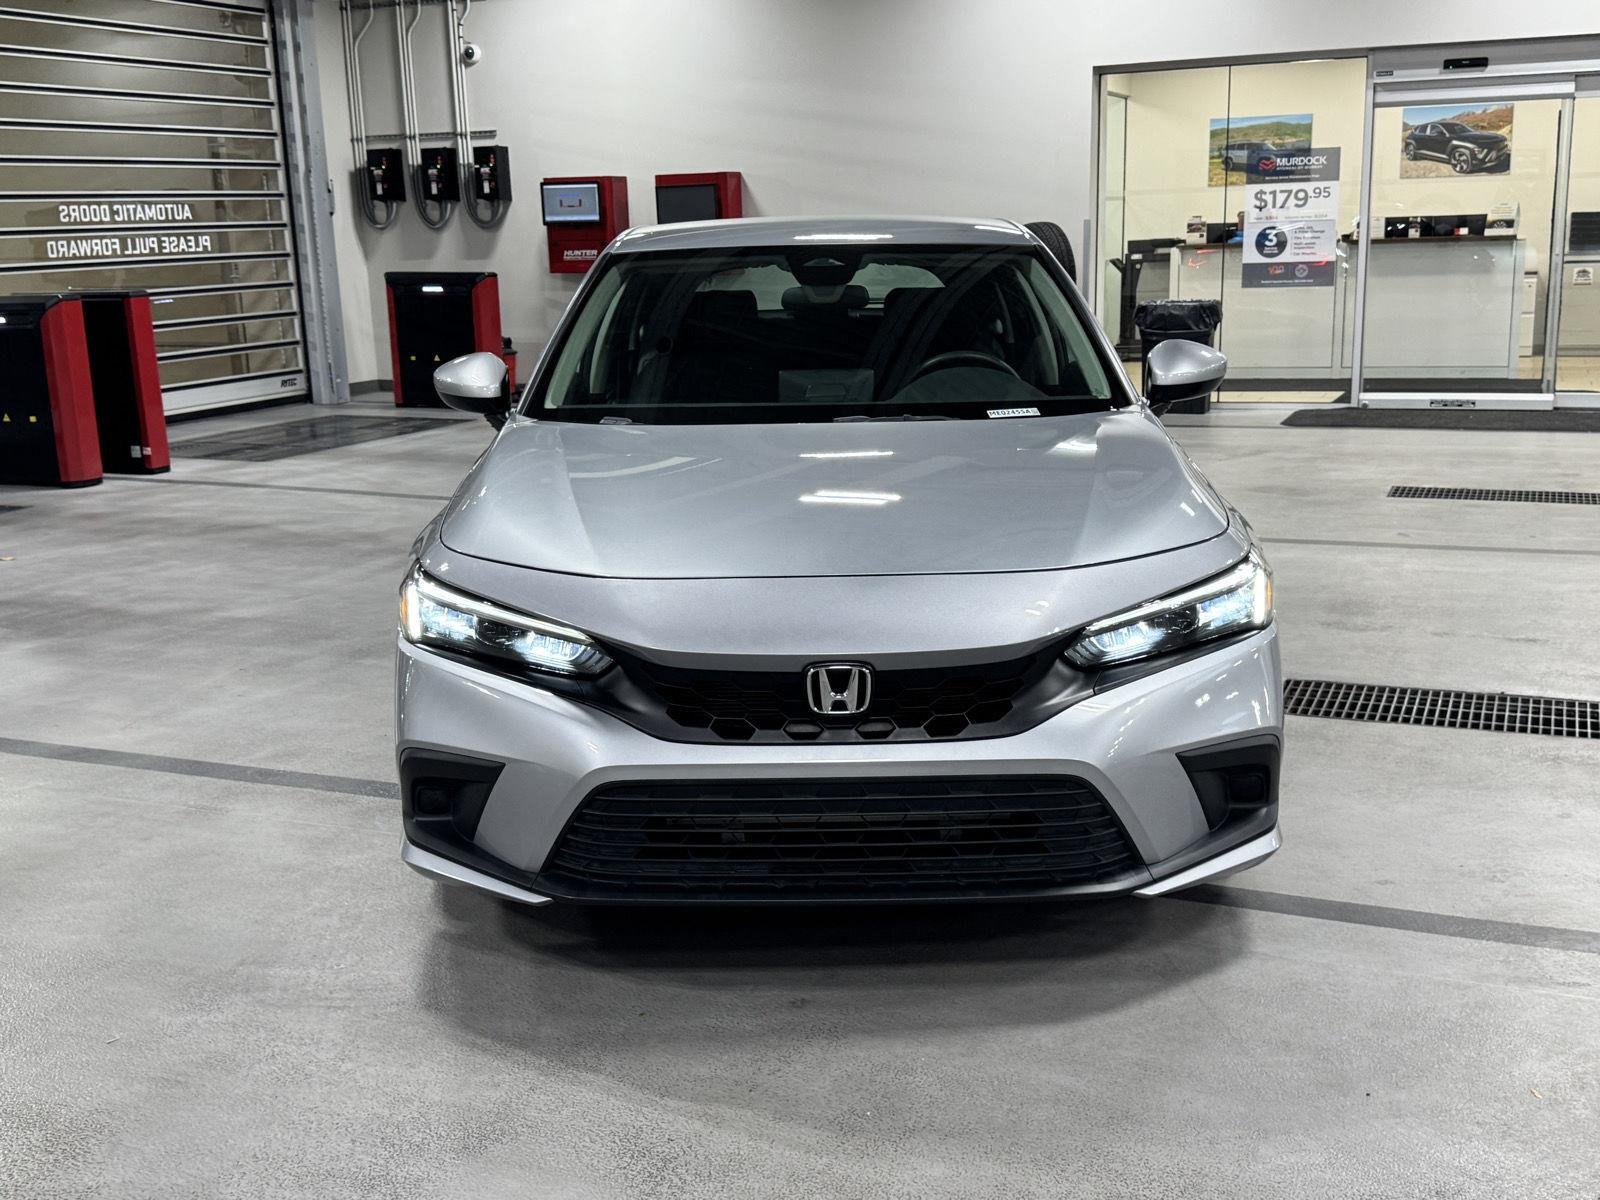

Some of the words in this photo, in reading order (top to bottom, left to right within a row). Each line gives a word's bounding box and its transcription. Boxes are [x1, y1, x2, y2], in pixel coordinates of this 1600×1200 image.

[1276, 155, 1327, 166] MURDOCK
[1264, 229, 1278, 246] 3
[563, 249, 598, 257] HUNTER
